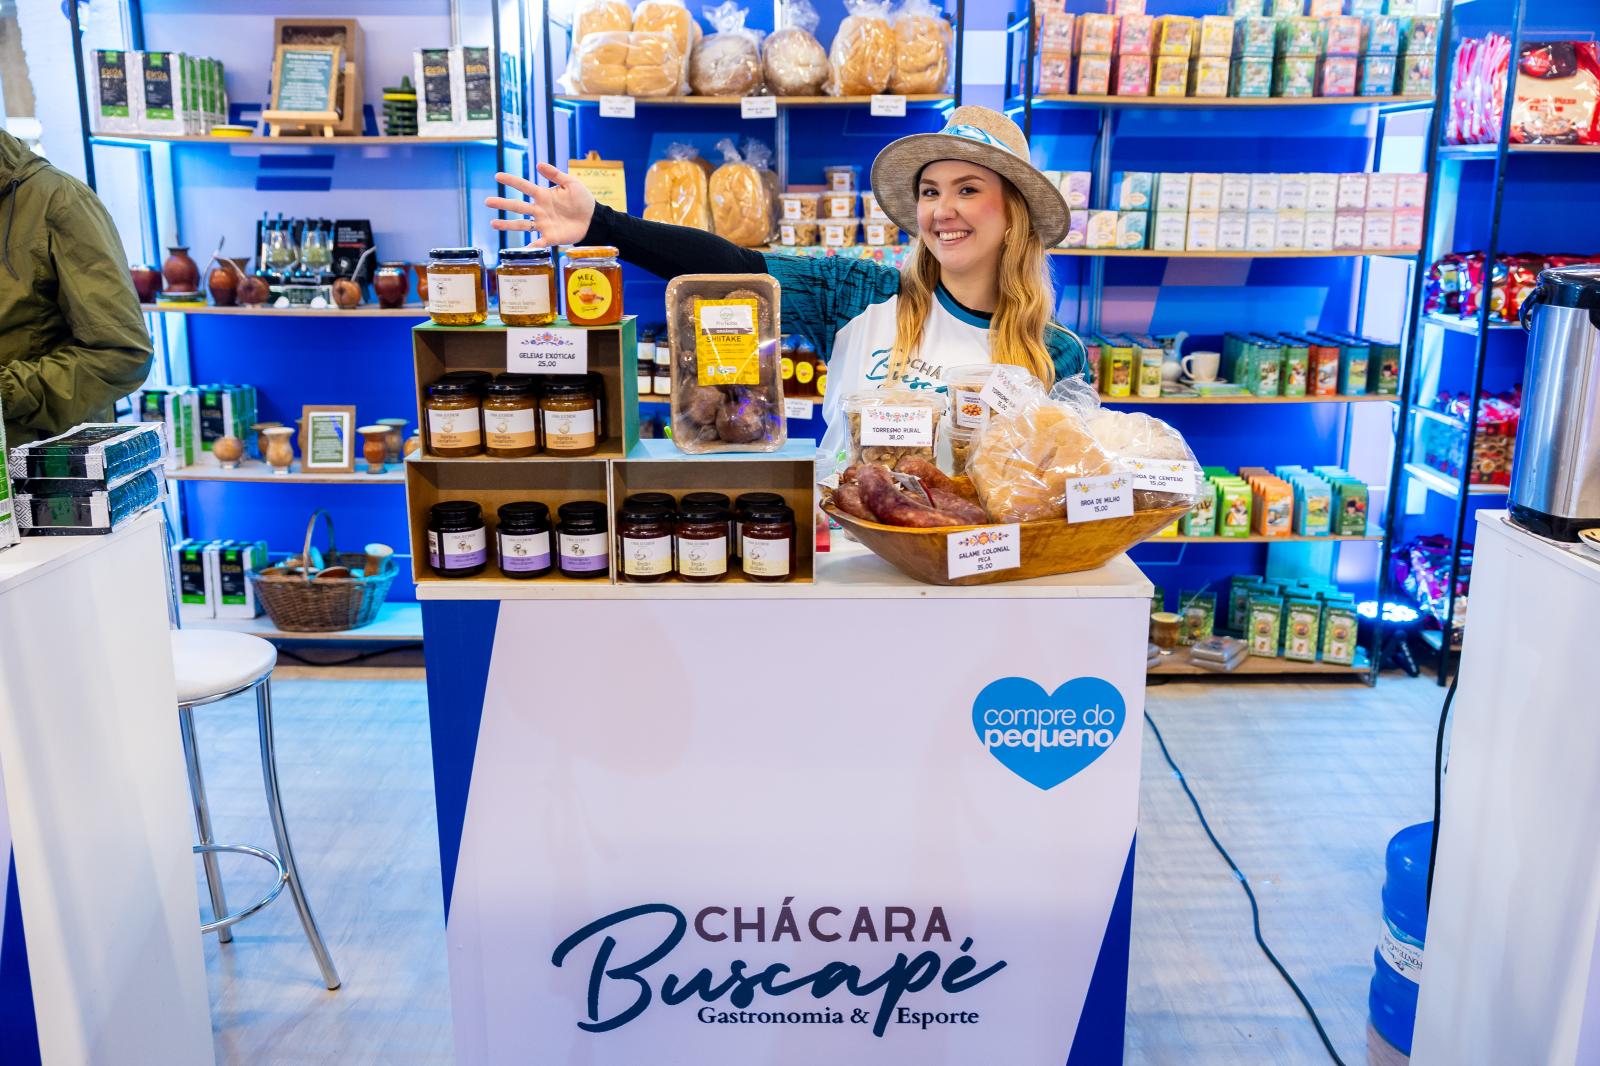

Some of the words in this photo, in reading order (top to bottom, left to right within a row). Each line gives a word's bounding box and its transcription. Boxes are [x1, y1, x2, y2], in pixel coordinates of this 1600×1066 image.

[577, 273, 595, 281] MEL
[706, 335, 742, 343] SHIITAKE
[1080, 498, 1095, 507] BROA
[1104, 496, 1121, 504] MILHO
[958, 550, 980, 560] SALAME
[982, 545, 1011, 555] COLONIAL
[984, 708, 1077, 731] compre
[1083, 704, 1115, 726] do
[984, 728, 1114, 753] pequeno
[694, 896, 953, 943] CHÁCARA
[551, 903, 1008, 1038] Buscapé
[697, 1006, 844, 1025] Gastronomia
[851, 1007, 870, 1025] &
[895, 1006, 980, 1031] Esporte
